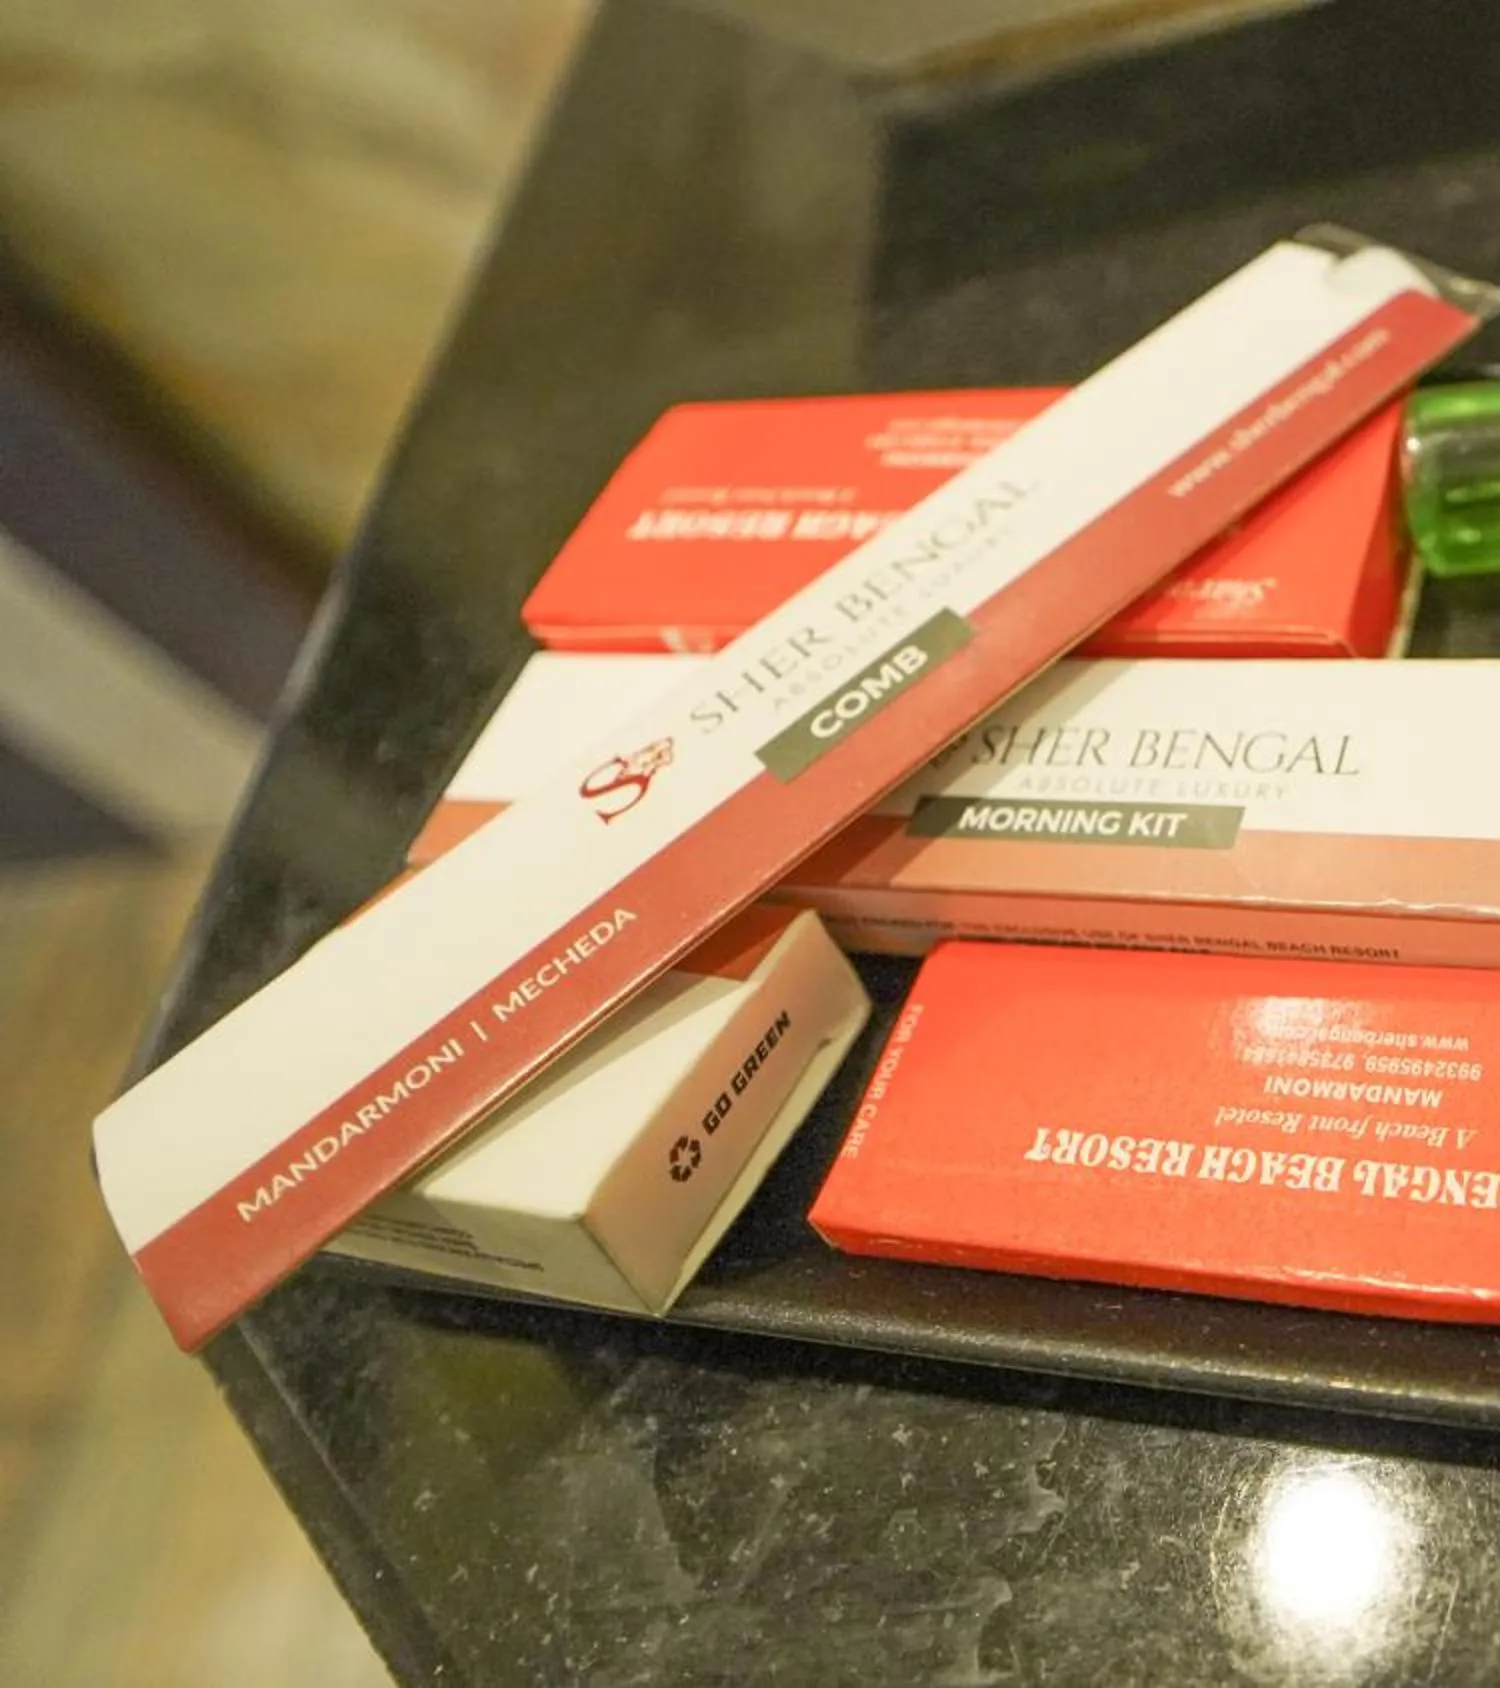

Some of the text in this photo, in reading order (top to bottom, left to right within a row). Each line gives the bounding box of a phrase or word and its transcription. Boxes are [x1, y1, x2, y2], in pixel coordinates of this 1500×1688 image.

[690, 476, 1041, 736] SHER BENGAL
[809, 645, 930, 740] COMB
[972, 725, 1111, 768] SHER
[1130, 729, 1361, 778] BENGAL
[1016, 775, 1294, 802] ABSOLUTE LUXURY
[956, 805, 1190, 839] MORNING KIT
[1265, 940, 1328, 954] BEACH
[1329, 945, 1400, 959] RESORT
[236, 1036, 466, 1222] MANDARMONI
[490, 906, 638, 1022] MECHEDA
[702, 1008, 791, 1136] GO GREEN
[840, 1003, 926, 1160] FOR YOUR CARE
[1263, 1074, 1443, 1109] MANDARMONI
[1023, 1126, 1196, 1178] RESORT
[1214, 1104, 1480, 1151] A Beach front Resotel
[1198, 1144, 1347, 1192] BEACH
